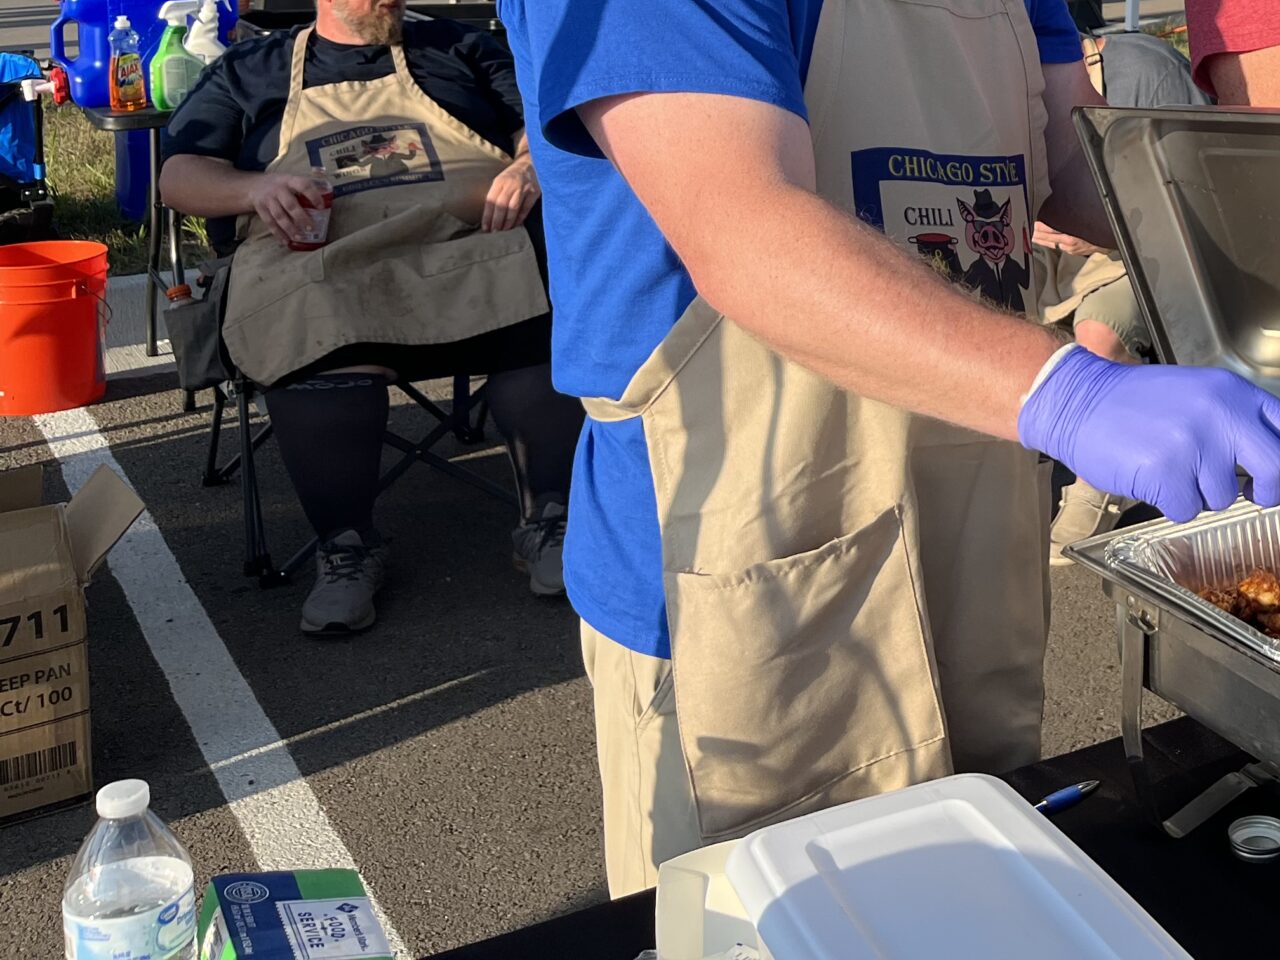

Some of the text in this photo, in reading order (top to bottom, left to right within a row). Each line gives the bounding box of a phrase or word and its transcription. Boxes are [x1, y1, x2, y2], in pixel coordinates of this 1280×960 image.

[121, 62, 139, 79] AJAX
[321, 126, 374, 147] CHICAGO
[329, 145, 357, 157] CHILI
[889, 155, 1019, 183] CHICAGO STYE
[35, 662, 72, 685] PAN
[37, 686, 73, 708] 100
[297, 912, 325, 948] SERVICE
[324, 916, 346, 939] FOOD
